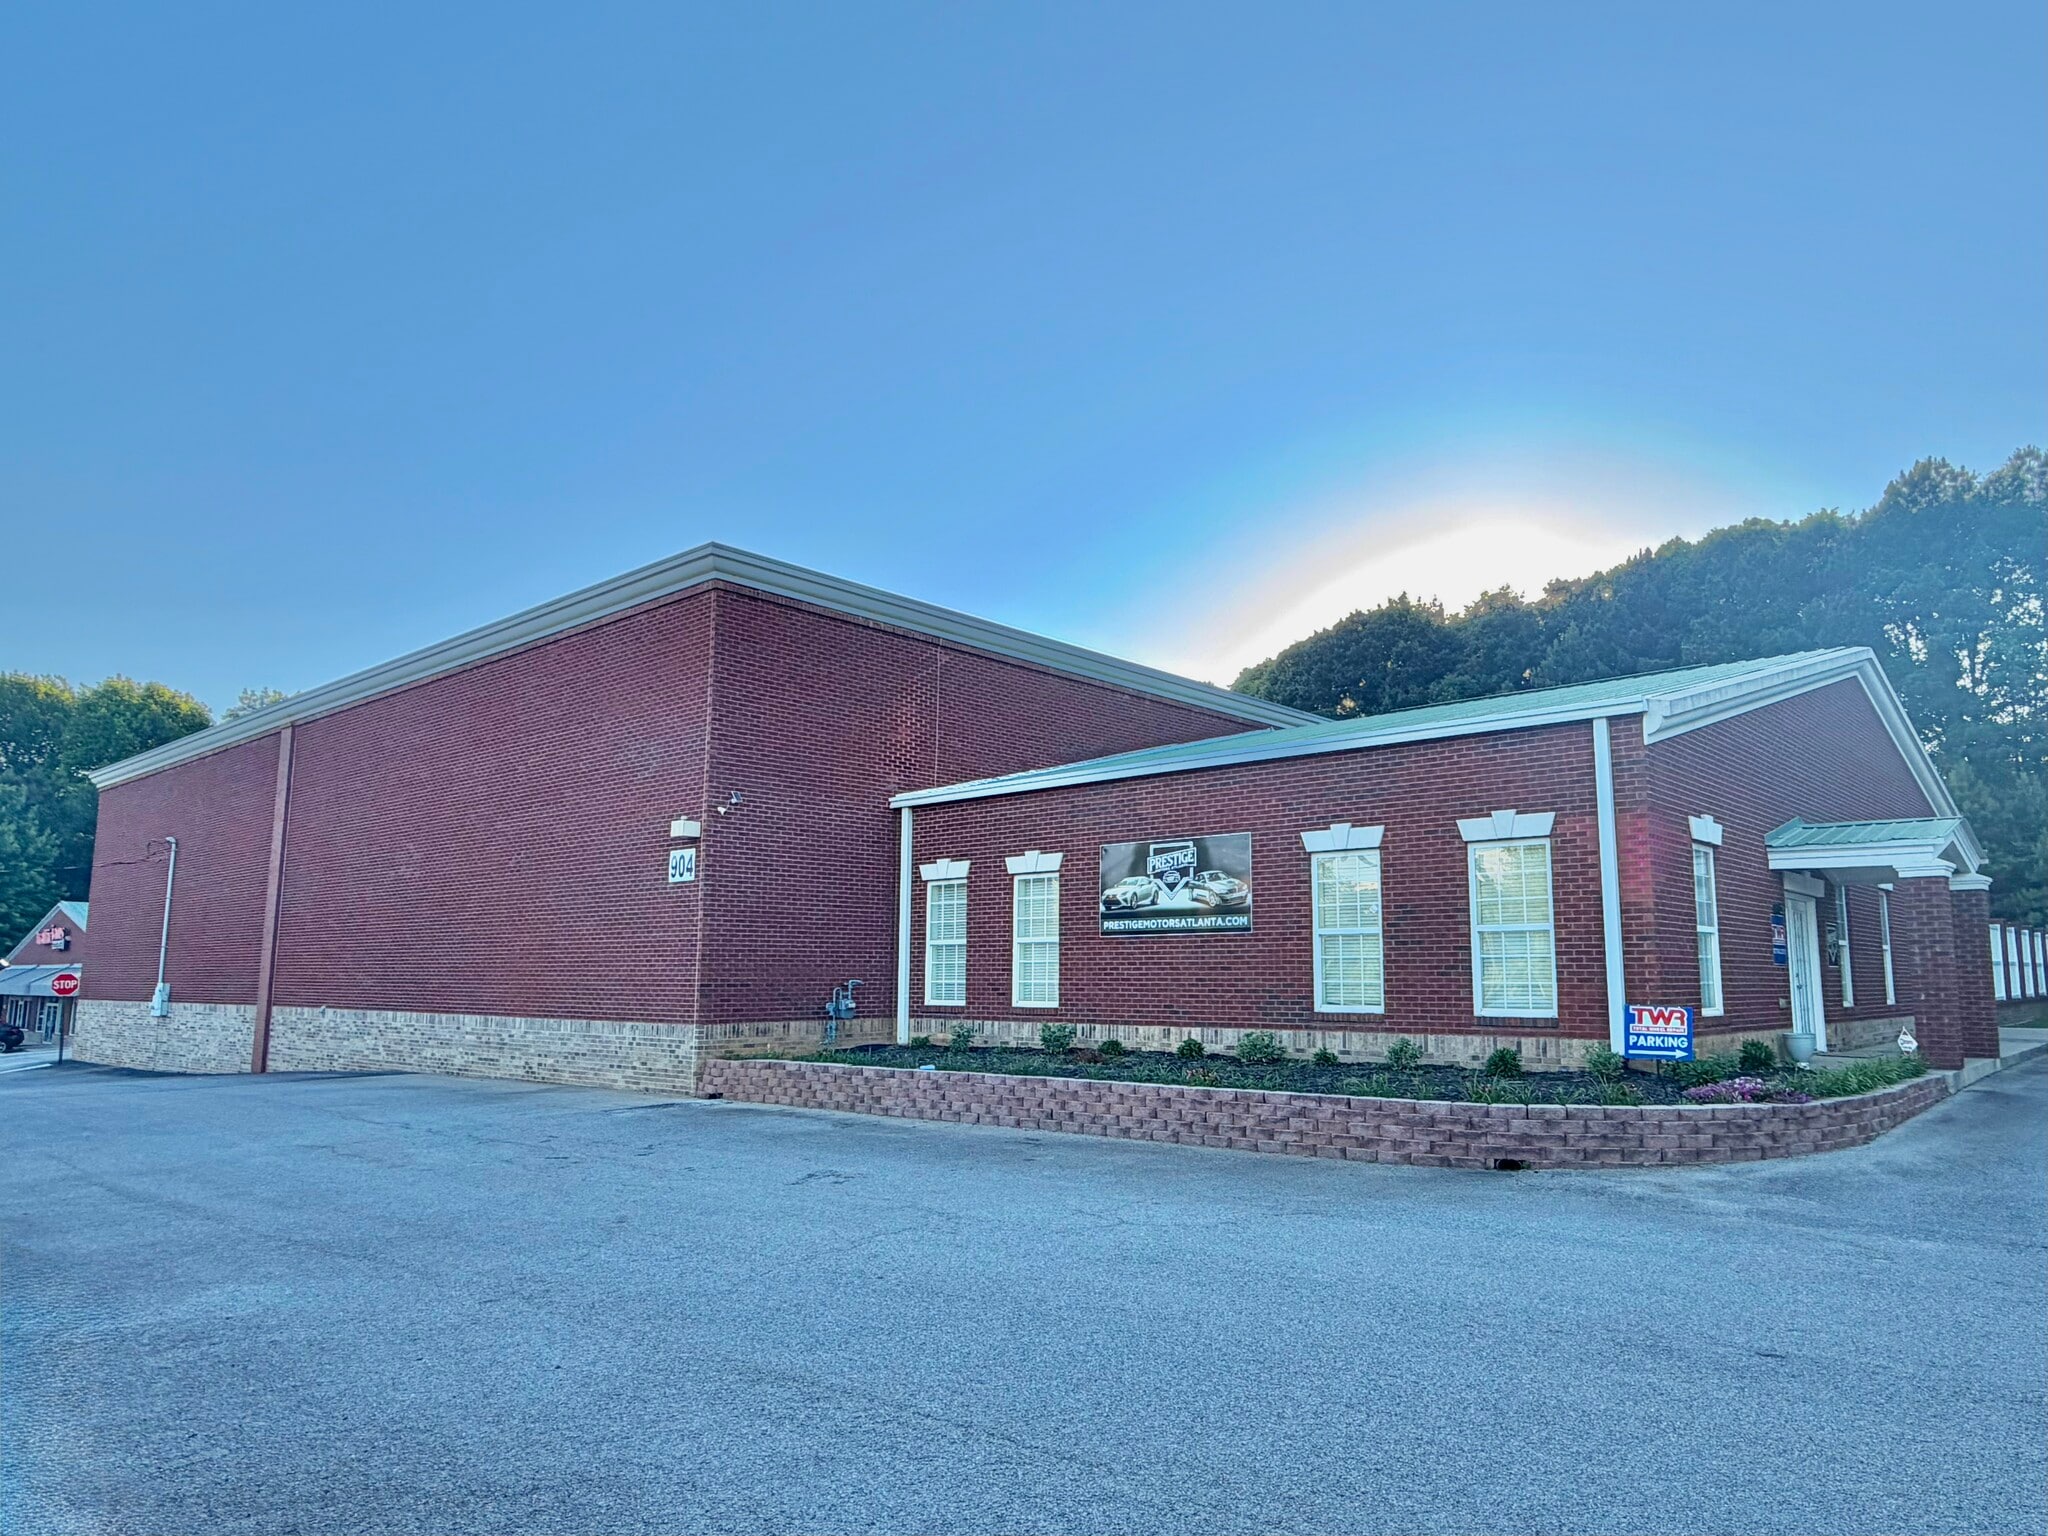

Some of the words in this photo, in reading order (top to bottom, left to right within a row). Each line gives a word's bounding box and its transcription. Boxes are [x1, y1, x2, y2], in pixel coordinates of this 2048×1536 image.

[671, 854, 693, 878] 904
[1150, 850, 1194, 872] PRESTIGE
[1103, 916, 1248, 930] PRESTIGEMOTORSATLANTA.COM
[53, 980, 77, 990] STOP
[1631, 1007, 1687, 1026] TWR
[1629, 1035, 1689, 1048] PARKING
